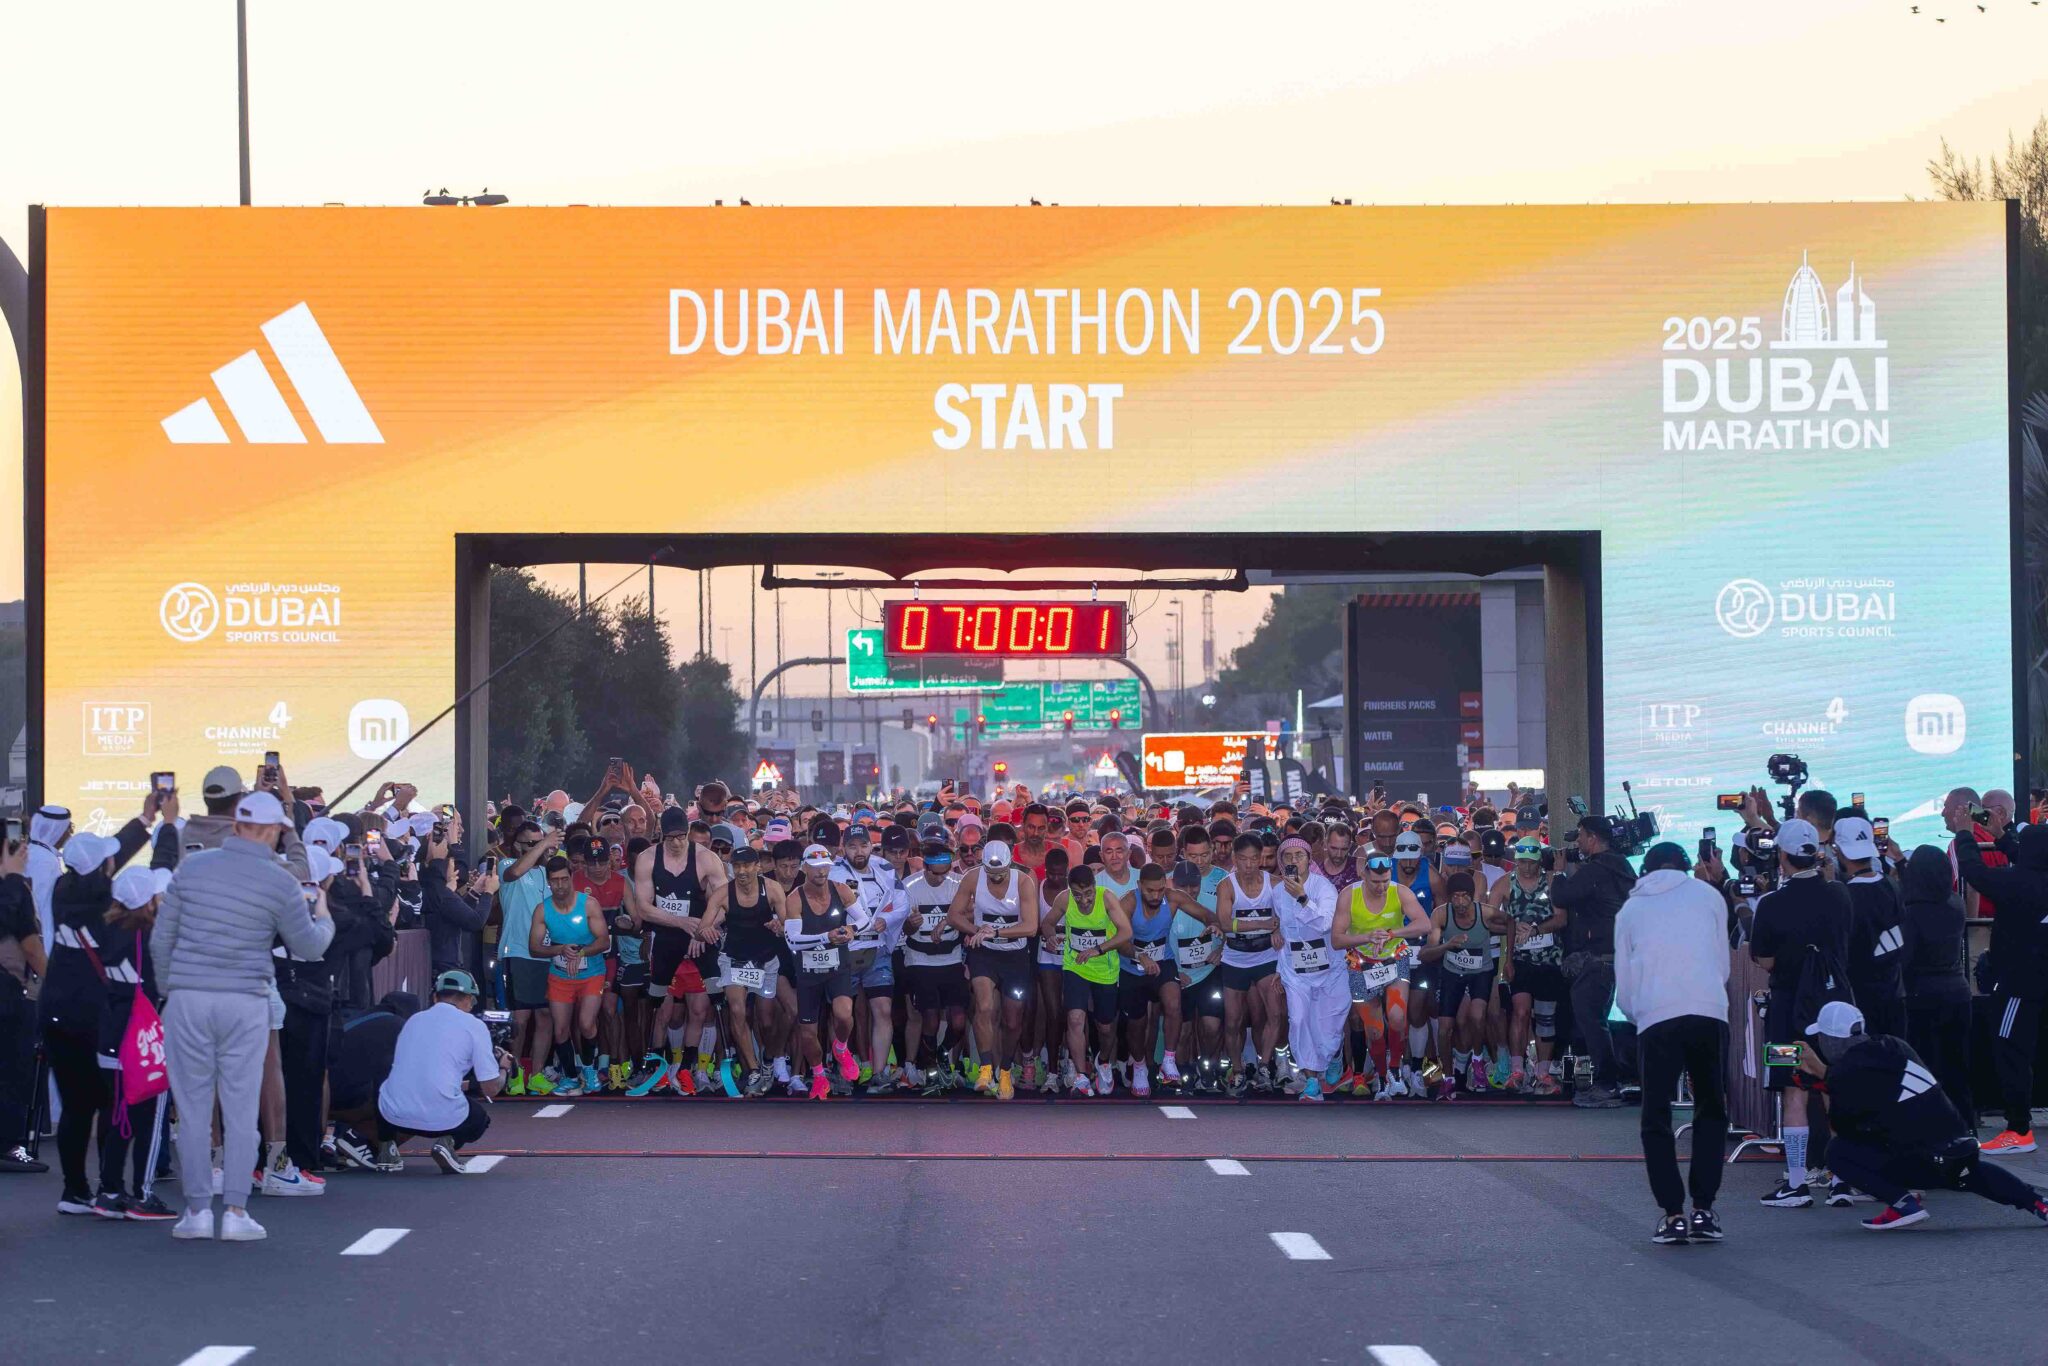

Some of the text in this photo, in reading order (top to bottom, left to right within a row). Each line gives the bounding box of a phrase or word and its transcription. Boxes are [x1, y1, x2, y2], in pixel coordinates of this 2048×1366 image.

[669, 286, 1385, 355] DUBAI MARATHON 2025
[1662, 315, 1762, 351] 2025
[1662, 356, 1889, 413] DUBAI
[932, 382, 1124, 450] START
[1662, 418, 1890, 451] MARATHON
[225, 597, 341, 627] DUBAI
[1780, 592, 1896, 622] DUBAI
[225, 631, 340, 643] SPORTS COUNCIL
[1781, 626, 1896, 639] SPORTS COUNCIL
[1363, 700, 1436, 711] FINISHERS PACKS
[91, 707, 145, 732] ITP
[204, 701, 293, 740] CHANNEL 4
[1648, 704, 1702, 728] ITP
[1761, 696, 1849, 736] CHANNEL 4
[1363, 730, 1393, 741] WATER
[1363, 761, 1405, 772] BAGGAGE
[1637, 776, 1713, 788] JETOUR
[661, 900, 683, 912] 2482
[1078, 938, 1098, 948] 1244
[811, 952, 830, 962] 586
[1188, 946, 1205, 957] 252
[1300, 951, 1319, 962] 544
[1454, 954, 1475, 965] 1608
[738, 970, 760, 981] 2253
[1370, 967, 1390, 981] 1354
